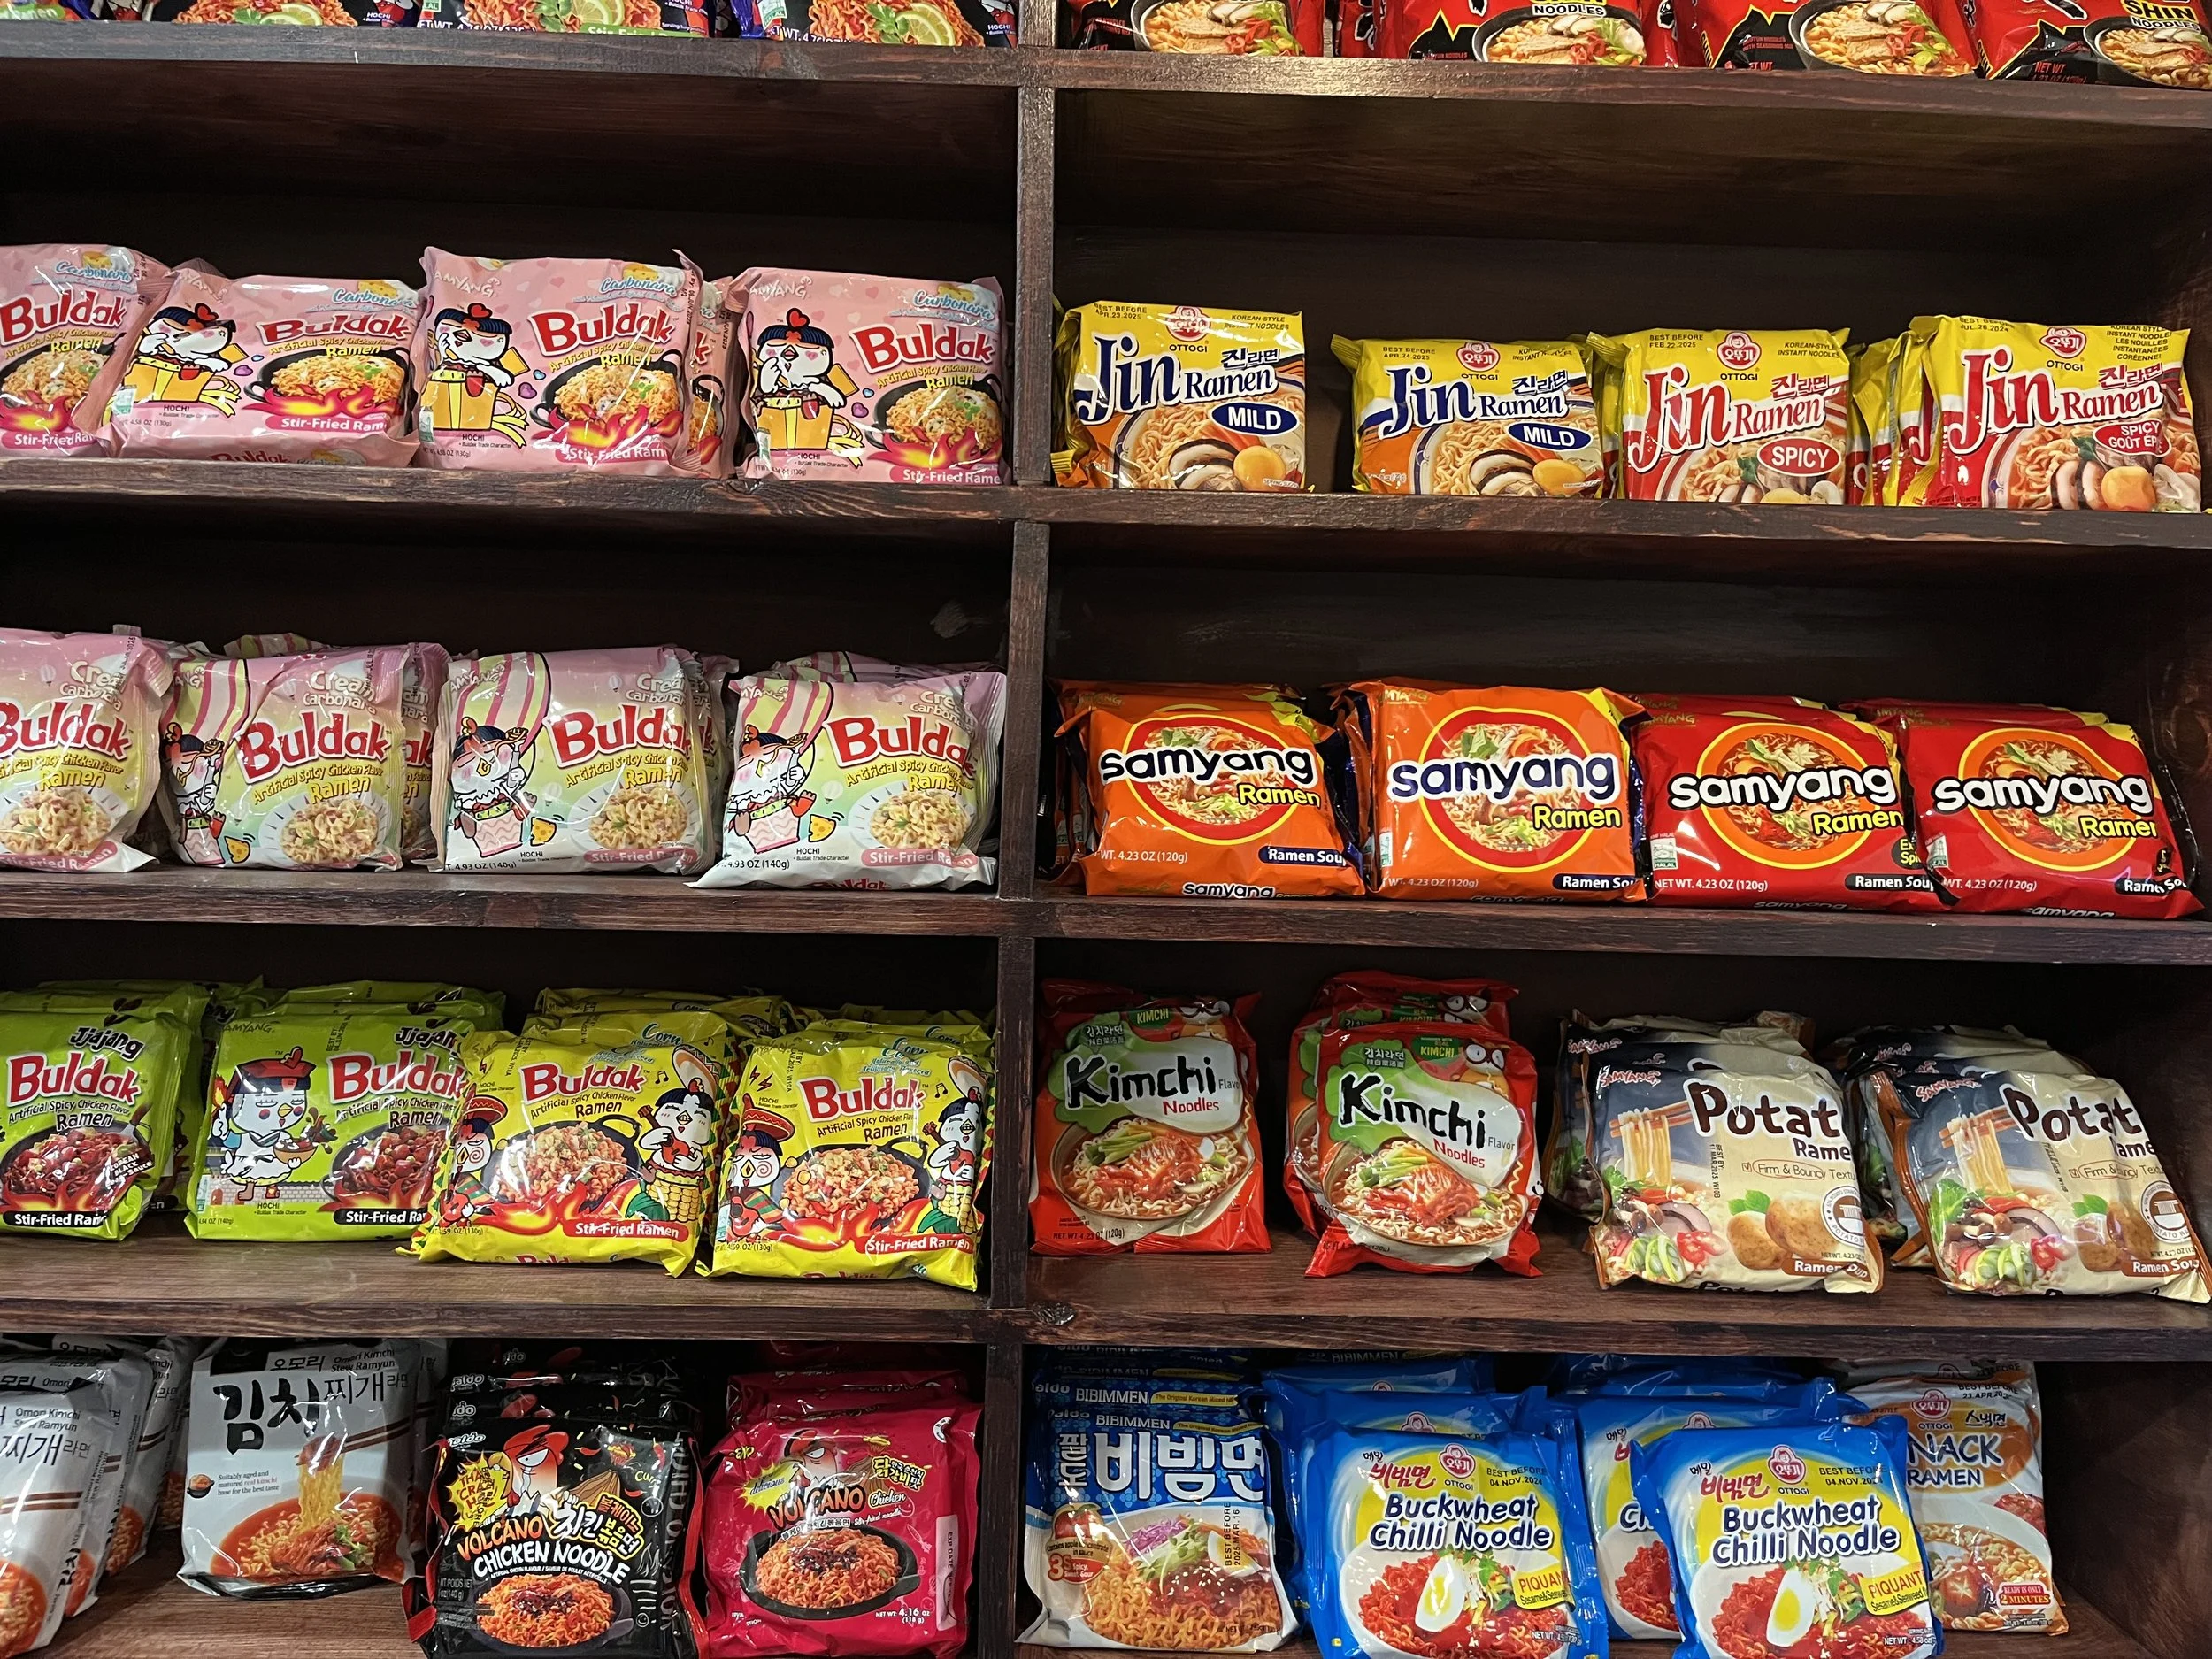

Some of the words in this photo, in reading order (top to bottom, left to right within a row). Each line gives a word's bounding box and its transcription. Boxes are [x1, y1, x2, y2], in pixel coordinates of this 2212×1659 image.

[1533, 4, 1605, 17] NOODLES
[2125, 2, 2197, 19] SHIN
[2, 292, 125, 343] Buldak
[262, 315, 411, 343] Buldak
[533, 304, 674, 354] Buldak
[326, 345, 380, 357] Ramen
[853, 323, 994, 370] Buldak
[1170, 343, 1207, 352] OTTOGI
[2049, 336, 2078, 349] 오뚜기
[1222, 349, 1280, 368] 진라면
[1464, 353, 1493, 365] 오뚜기
[1725, 349, 1755, 360] 오뚜기
[2047, 360, 2083, 371] OTTOGI
[926, 373, 973, 389] Ramen
[1074, 336, 1180, 421] Jin
[1186, 370, 1272, 398] Ramen
[1771, 373, 1830, 398] 진라면
[2099, 364, 2162, 388] 진라면
[1379, 367, 1476, 437] Jin
[1481, 396, 1563, 416] Ramen
[1947, 349, 2059, 451] Jin
[2061, 383, 2157, 420] Ramen
[281, 418, 349, 431] Stir-Fried
[1228, 407, 1281, 430] MILD
[1630, 366, 1731, 470] Jin
[1734, 398, 1820, 437] Ramen
[1524, 426, 1575, 446] MILD
[2121, 422, 2159, 436] SPICY
[1772, 446, 1829, 468] SPICY
[242, 712, 388, 779] Buldak
[846, 762, 898, 787] Artificial
[899, 761, 926, 773] Spicy
[929, 761, 956, 777] Chicken
[1101, 749, 1314, 787] samyang
[1393, 757, 1614, 800] samyang
[311, 777, 370, 803] Ramen
[1240, 785, 1320, 807] Ramen
[1671, 768, 1896, 811] samyang
[1935, 775, 2153, 814] samyang
[1534, 807, 1620, 828] Ramen
[1814, 812, 1904, 834] Ramen
[592, 852, 654, 862] Stir-Fried
[728, 859, 745, 869] 4.93
[762, 859, 789, 870] (140g)
[870, 851, 933, 864] Stir-Fried
[1101, 851, 1117, 861] WT.
[1118, 851, 1139, 861] 4.23
[1141, 852, 1156, 861] OZ
[1157, 852, 1187, 864] (120g)
[1269, 849, 1314, 862] Ramen
[1563, 877, 1609, 888] Ramen
[1655, 879, 1674, 889] NET
[1676, 879, 1694, 889] WT.
[1695, 880, 1717, 889] 4.23
[1719, 880, 1733, 889] OZ
[1736, 881, 1768, 891] (120g)
[1855, 876, 1902, 887] Ramen
[1965, 879, 1985, 889] 4.23
[1988, 880, 2003, 889] OZ
[2005, 880, 2037, 892] (120g)
[1137, 1008, 1169, 1024] KIMCHI
[1087, 1025, 1124, 1036] 김치라면
[1365, 1048, 1404, 1060] 김치라면
[1421, 1045, 1455, 1057] KIMCHI
[10, 1053, 140, 1102] Buldak
[331, 1053, 469, 1102] Buldak
[521, 1064, 646, 1103] Buldak
[1067, 1056, 1216, 1109] Kimchi
[1600, 1071, 1661, 1087] SAMYANG
[800, 1078, 925, 1120] Buldak
[1164, 1099, 1219, 1115] Noodles
[9, 1102, 48, 1124] Artificial
[50, 1101, 74, 1111] Spicy
[78, 1100, 107, 1110] Chicken
[110, 1104, 129, 1115] Flavor
[576, 1102, 622, 1118] Ramen
[1340, 1075, 1486, 1149] Kimchi
[1488, 1137, 1515, 1150] Flavor
[1688, 1081, 1840, 1138] Potat
[2004, 1087, 2142, 1141] Potat
[57, 1111, 113, 1130] Ramen
[818, 1120, 855, 1138] Artificial
[856, 1118, 877, 1127] Spicy
[864, 1124, 908, 1141] Ramen
[1433, 1139, 1485, 1169] Noodles
[15, 1214, 71, 1225] Stir-Fried
[347, 1211, 406, 1224] Stir-Fried
[868, 1237, 926, 1252] Stir-Fried
[930, 1237, 970, 1250] Ramen
[356, 1361, 395, 1371] Ramyun
[1076, 1388, 1148, 1404] BIBIMMEN
[213, 1378, 319, 1455] 김치
[324, 1373, 384, 1404] 찌개
[387, 1374, 409, 1388] 라면
[1919, 1401, 1947, 1413] 오뚜기
[1096, 1414, 1170, 1430] BIBIMMEN
[1909, 1434, 2001, 1464] NACK
[1094, 1432, 1263, 1502] 비빔면
[1447, 1457, 1469, 1472] 오뚜기
[1690, 1463, 1712, 1477] 메밀
[1775, 1463, 1801, 1479] 오뚜기
[1371, 1463, 1436, 1489] 비빔면
[1445, 1479, 1473, 1490] OTTOGI
[1908, 1469, 1981, 1486] RAMEN
[1701, 1473, 1770, 1502] 비빔면
[1386, 1494, 1538, 1520] Buckwheat
[1724, 1497, 1879, 1533] Buckwheat
[1371, 1522, 1445, 1548] Chilli
[1455, 1523, 1550, 1549] Noodle
[1712, 1534, 1786, 1567] Chilli
[1798, 1525, 1899, 1557] Noodle
[475, 1542, 548, 1577] CHICKEN
[554, 1542, 629, 1584] NOODLE
[2000, 1594, 2008, 1604] 2
[2010, 1594, 2050, 1604] MINUTES
[899, 1608, 919, 1617] 4.16
